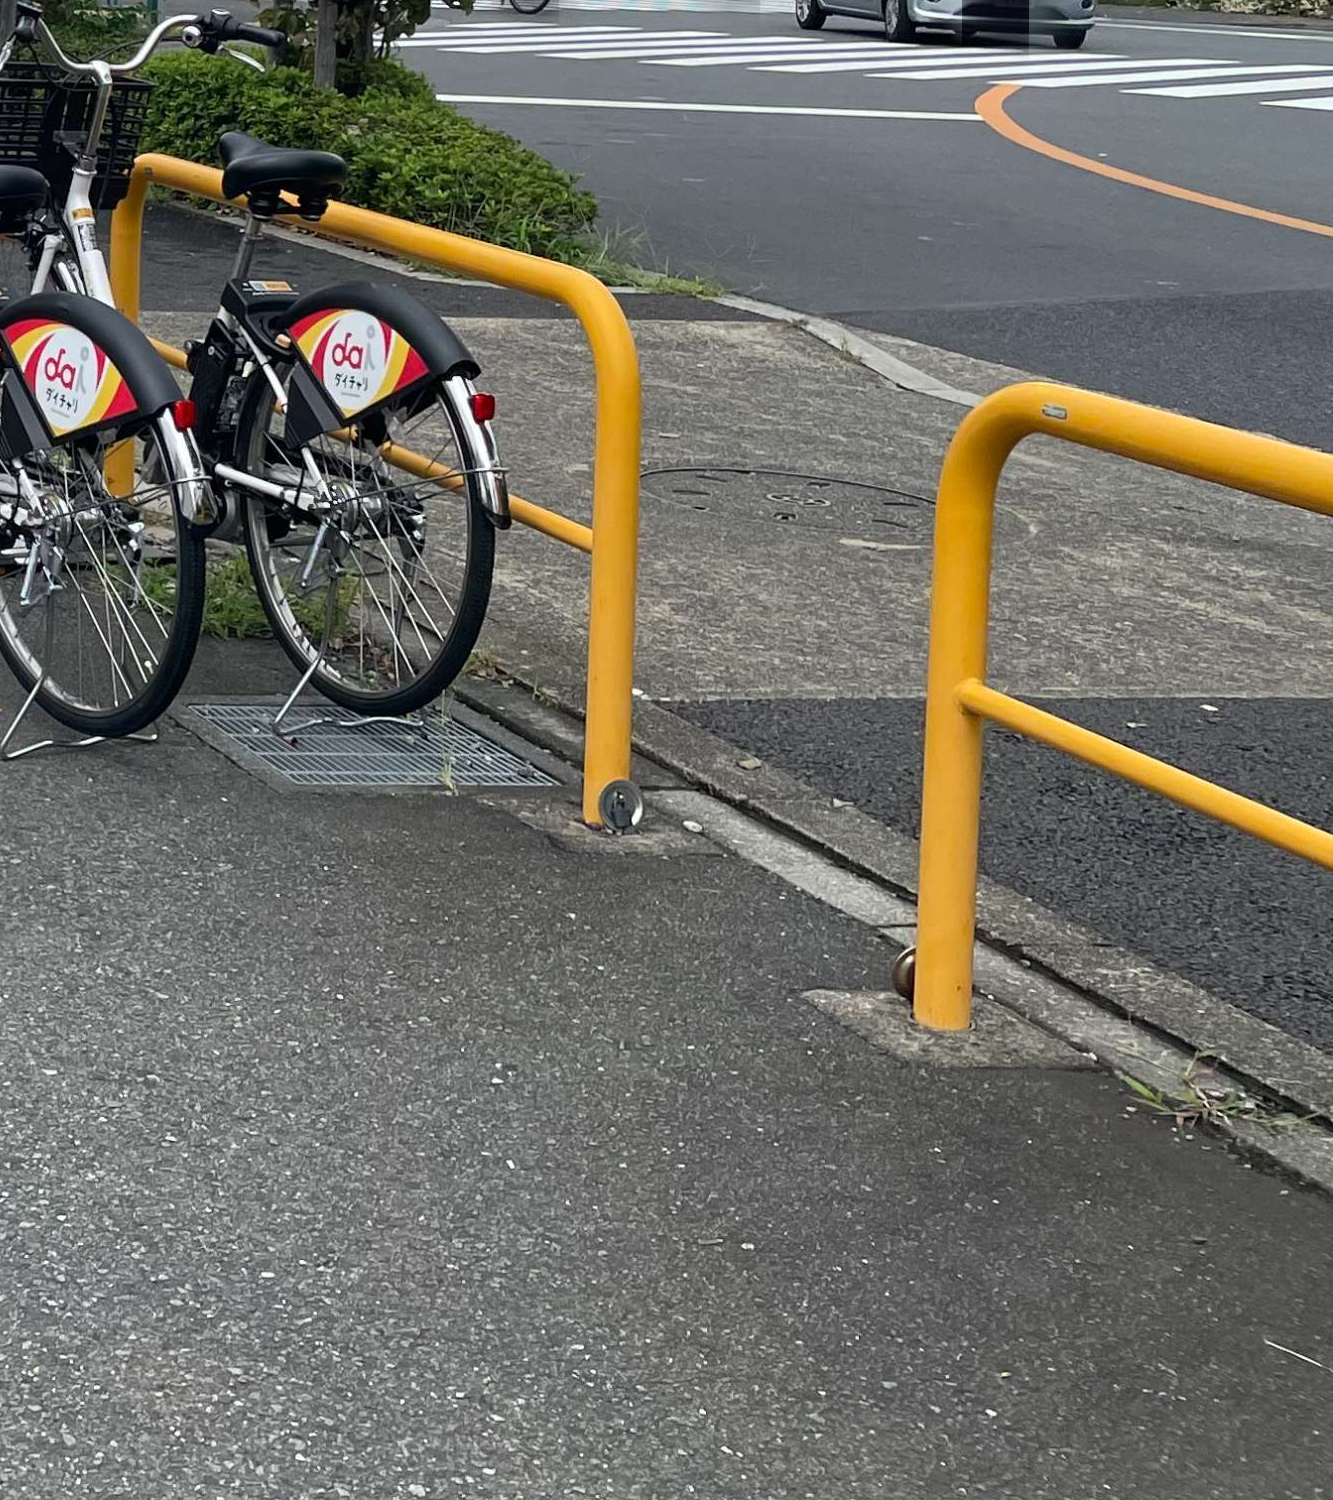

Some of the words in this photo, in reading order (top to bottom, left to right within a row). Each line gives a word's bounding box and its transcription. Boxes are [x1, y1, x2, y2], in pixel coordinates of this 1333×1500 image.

[332, 324, 376, 371] dai
[44, 345, 90, 394] dai
[335, 372, 369, 392] ダイチャリ
[45, 387, 78, 413] ダイチャリ
